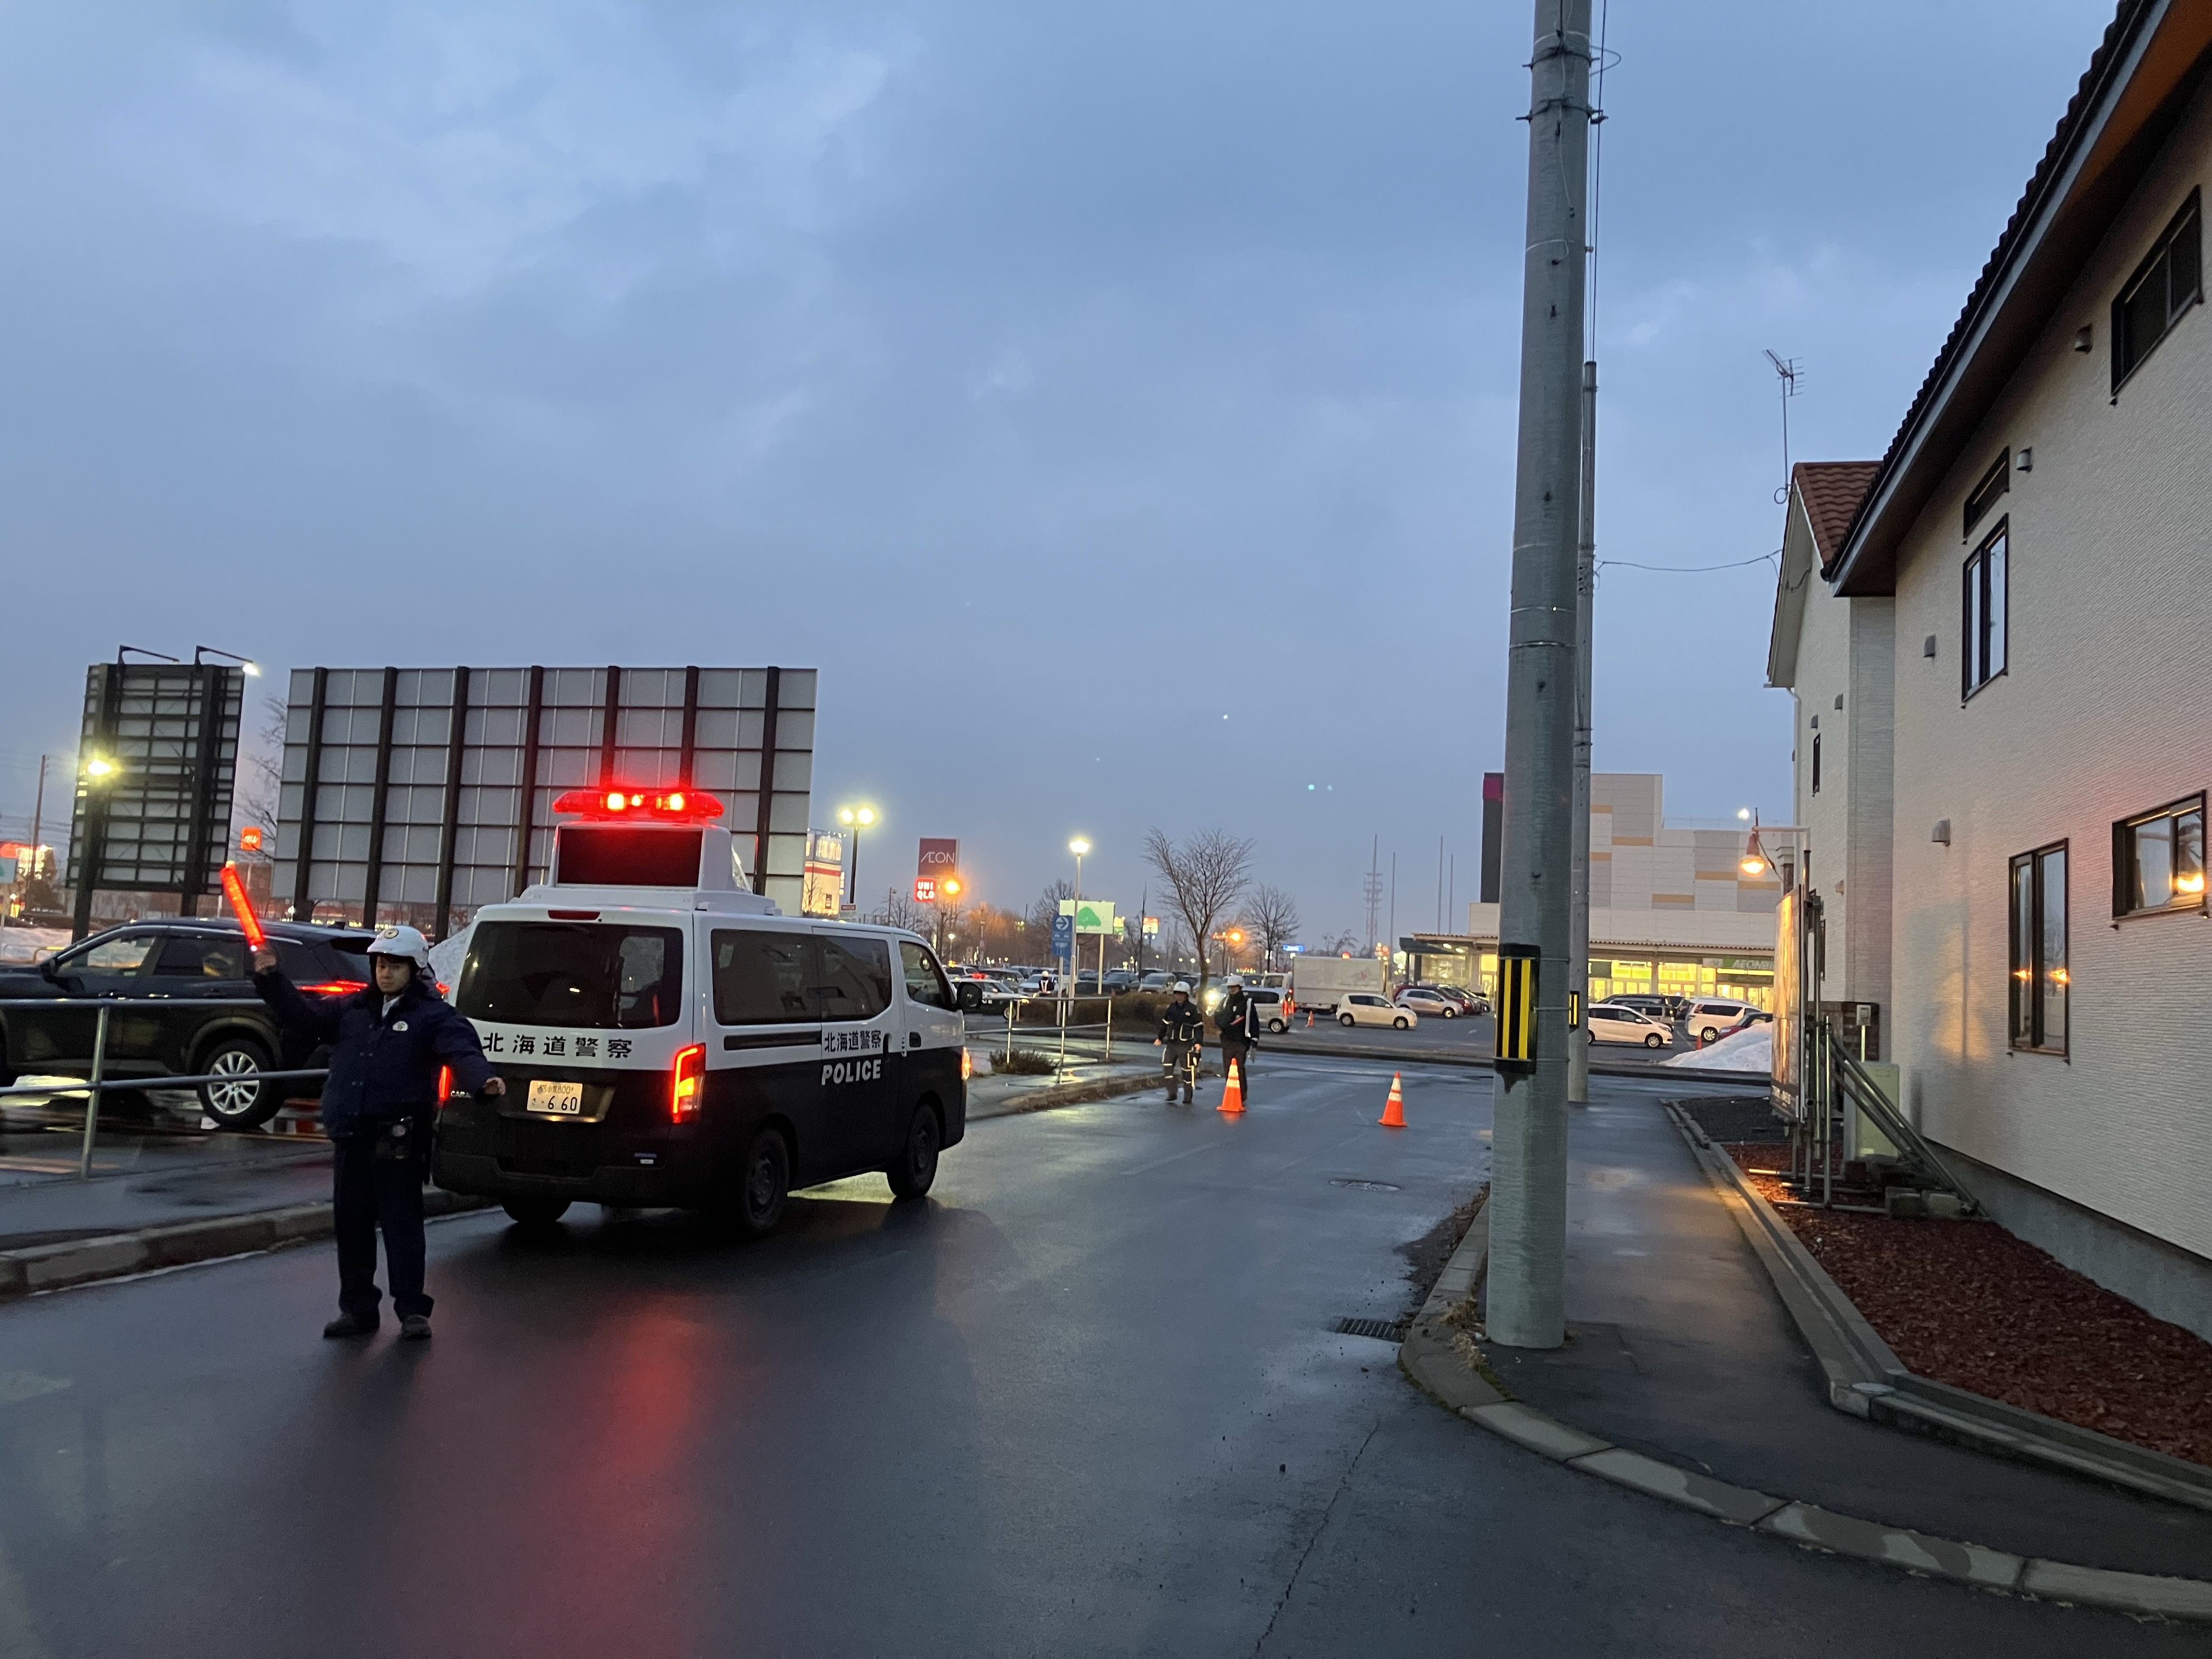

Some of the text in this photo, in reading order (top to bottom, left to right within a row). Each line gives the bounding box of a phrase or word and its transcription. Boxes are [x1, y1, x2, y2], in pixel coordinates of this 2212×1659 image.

[244, 835, 258, 843] au
[917, 881, 934, 890] UNI
[917, 890, 935, 900] QLO
[483, 1032, 632, 1058] 北海道警察
[824, 1030, 881, 1052] 北海道警察
[821, 1059, 882, 1086] POLICE
